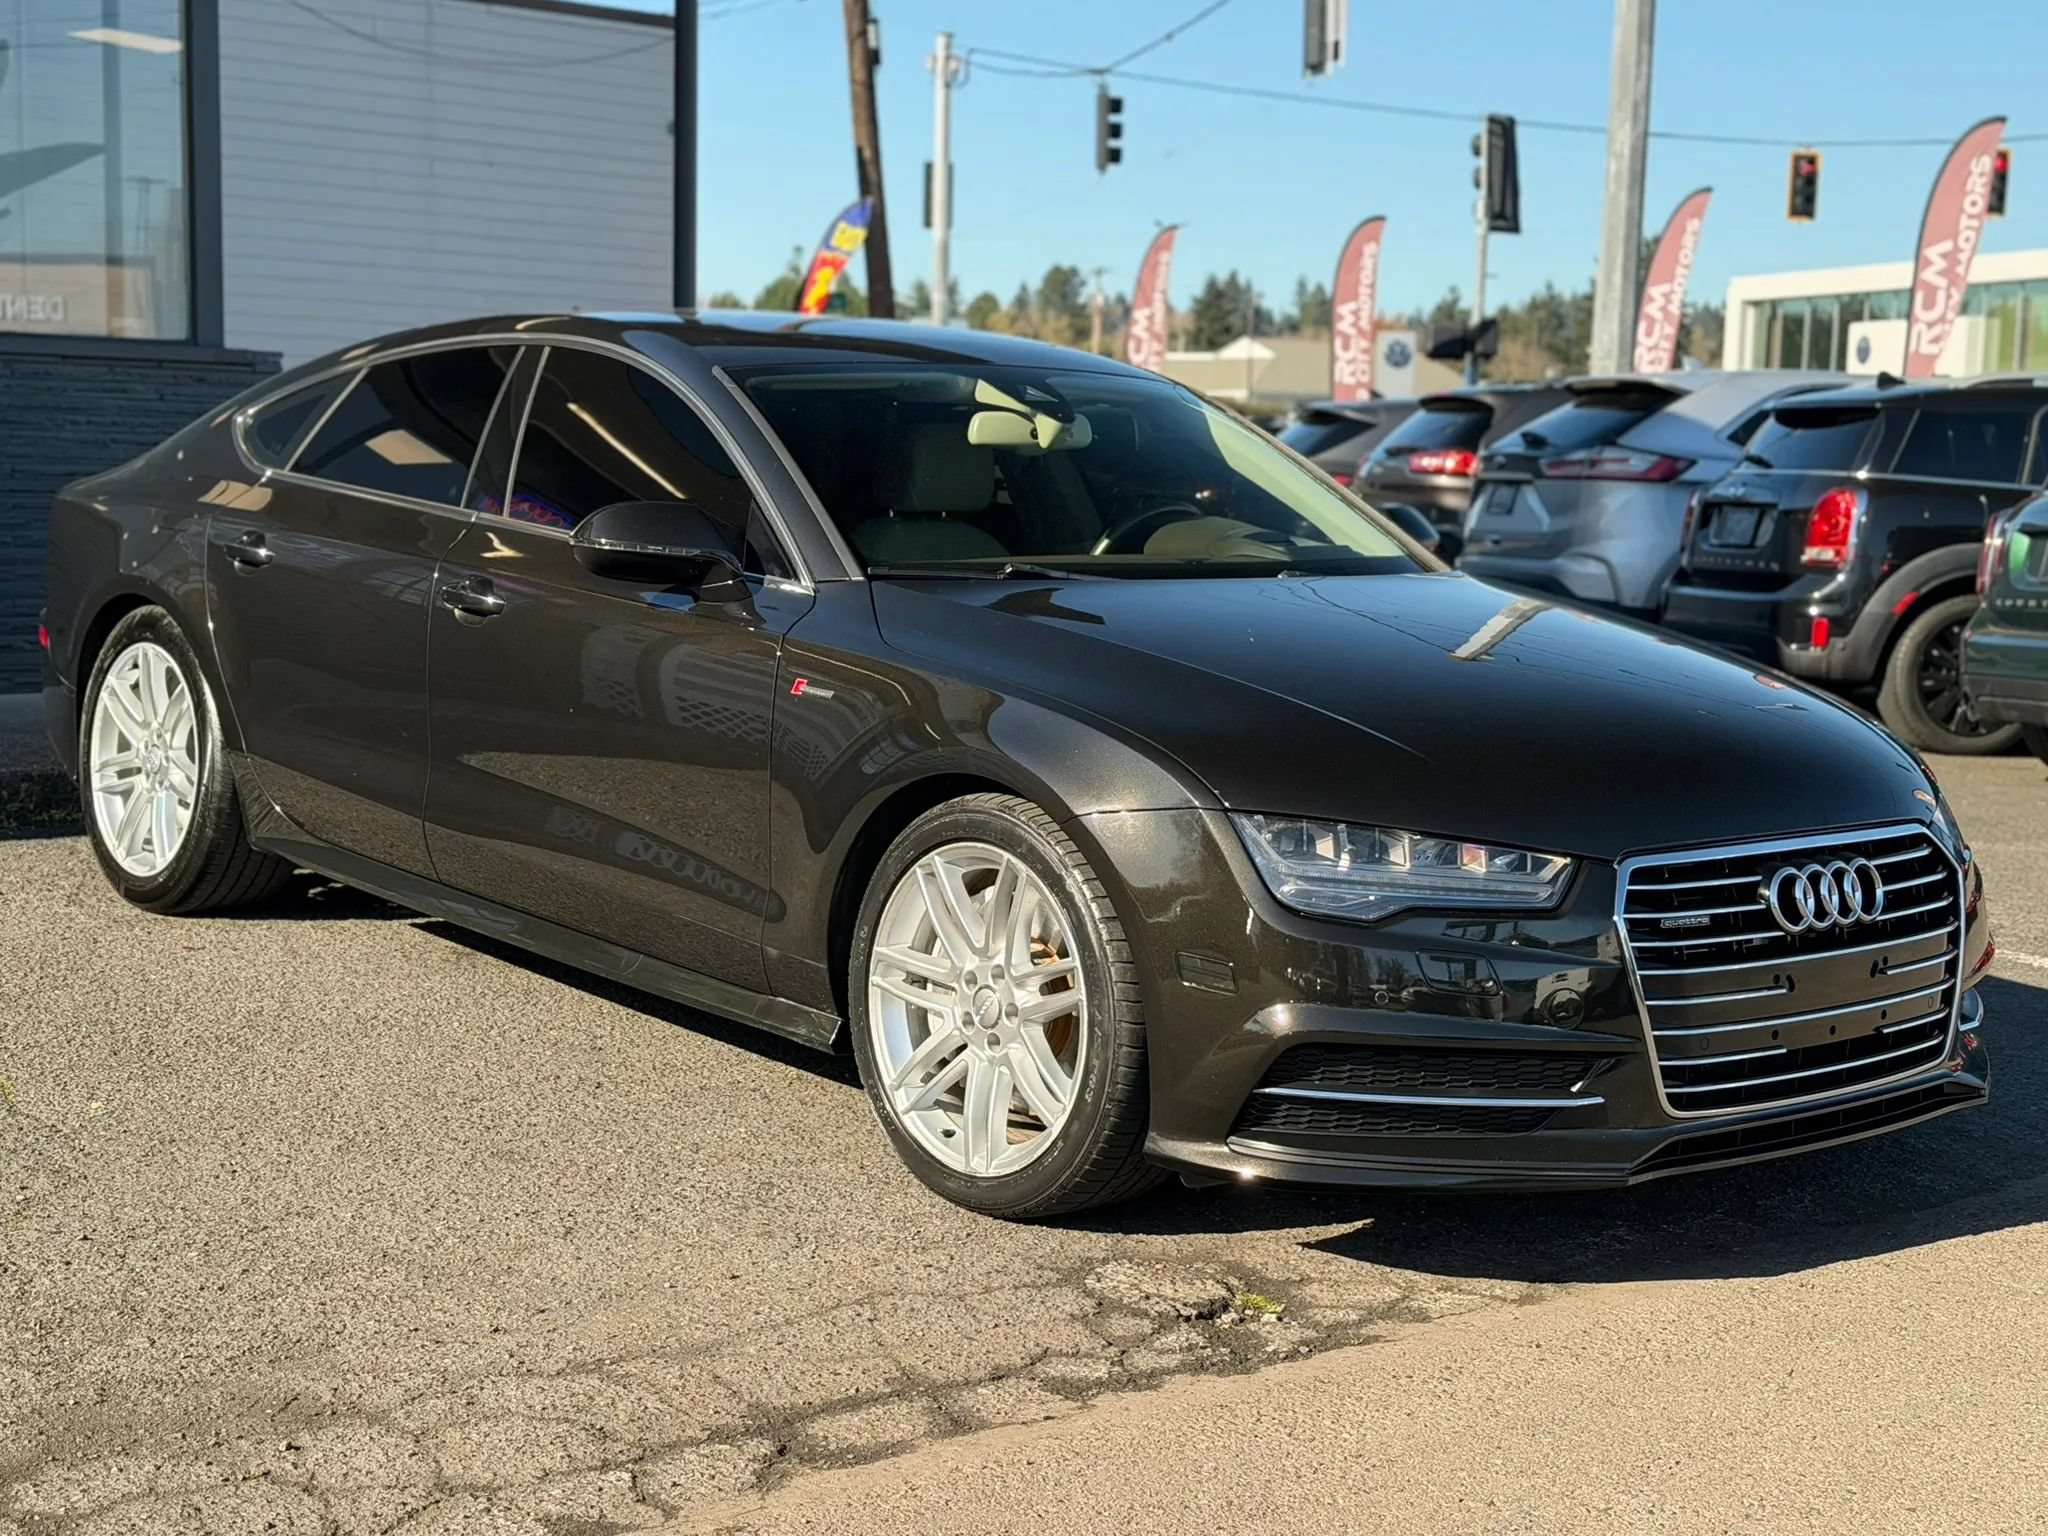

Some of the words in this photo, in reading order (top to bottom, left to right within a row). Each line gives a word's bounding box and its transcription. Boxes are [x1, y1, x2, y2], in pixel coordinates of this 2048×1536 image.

[1955, 154, 1993, 276] MOTORS
[1358, 241, 1378, 331] MOTORS
[1666, 217, 1701, 314] MOTORS
[1909, 239, 1954, 355] RCM
[1127, 307, 1151, 366] CM
[1333, 301, 1357, 386] RCM
[1634, 283, 1672, 373] RCM
[1663, 917, 1709, 927] quattro
